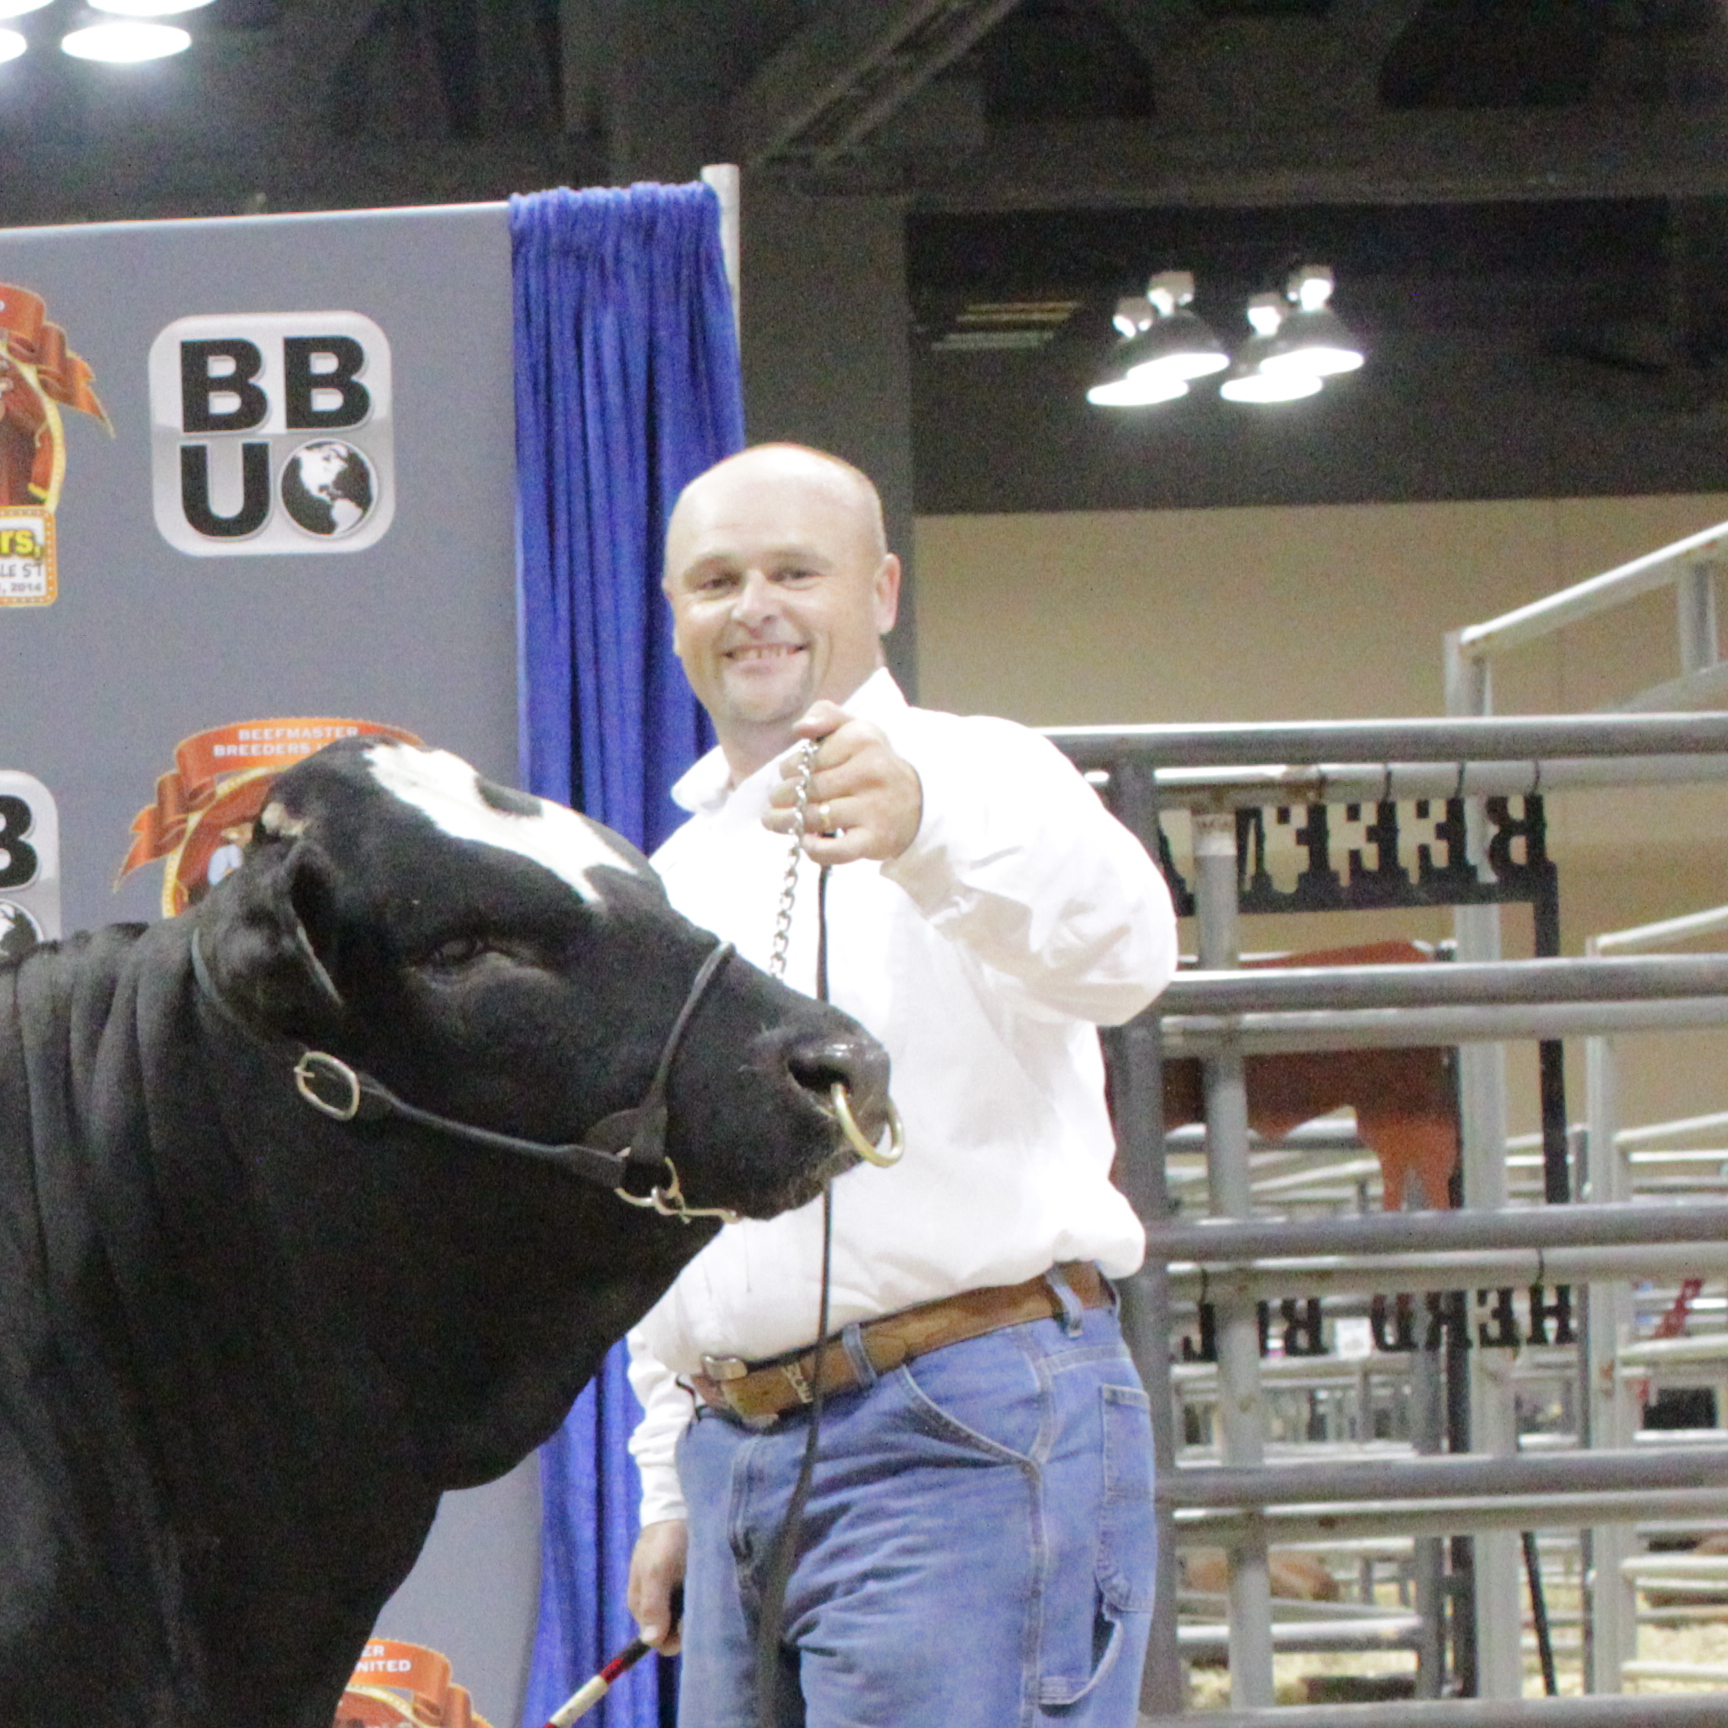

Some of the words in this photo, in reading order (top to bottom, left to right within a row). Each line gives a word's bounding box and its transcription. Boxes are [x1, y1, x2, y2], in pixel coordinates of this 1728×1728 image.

[180, 335, 371, 433] BB
[180, 443, 270, 537] U
[22, 560, 42, 577] ST
[238, 726, 359, 742] BEEFMASTER
[213, 742, 311, 757] BREEDERS
